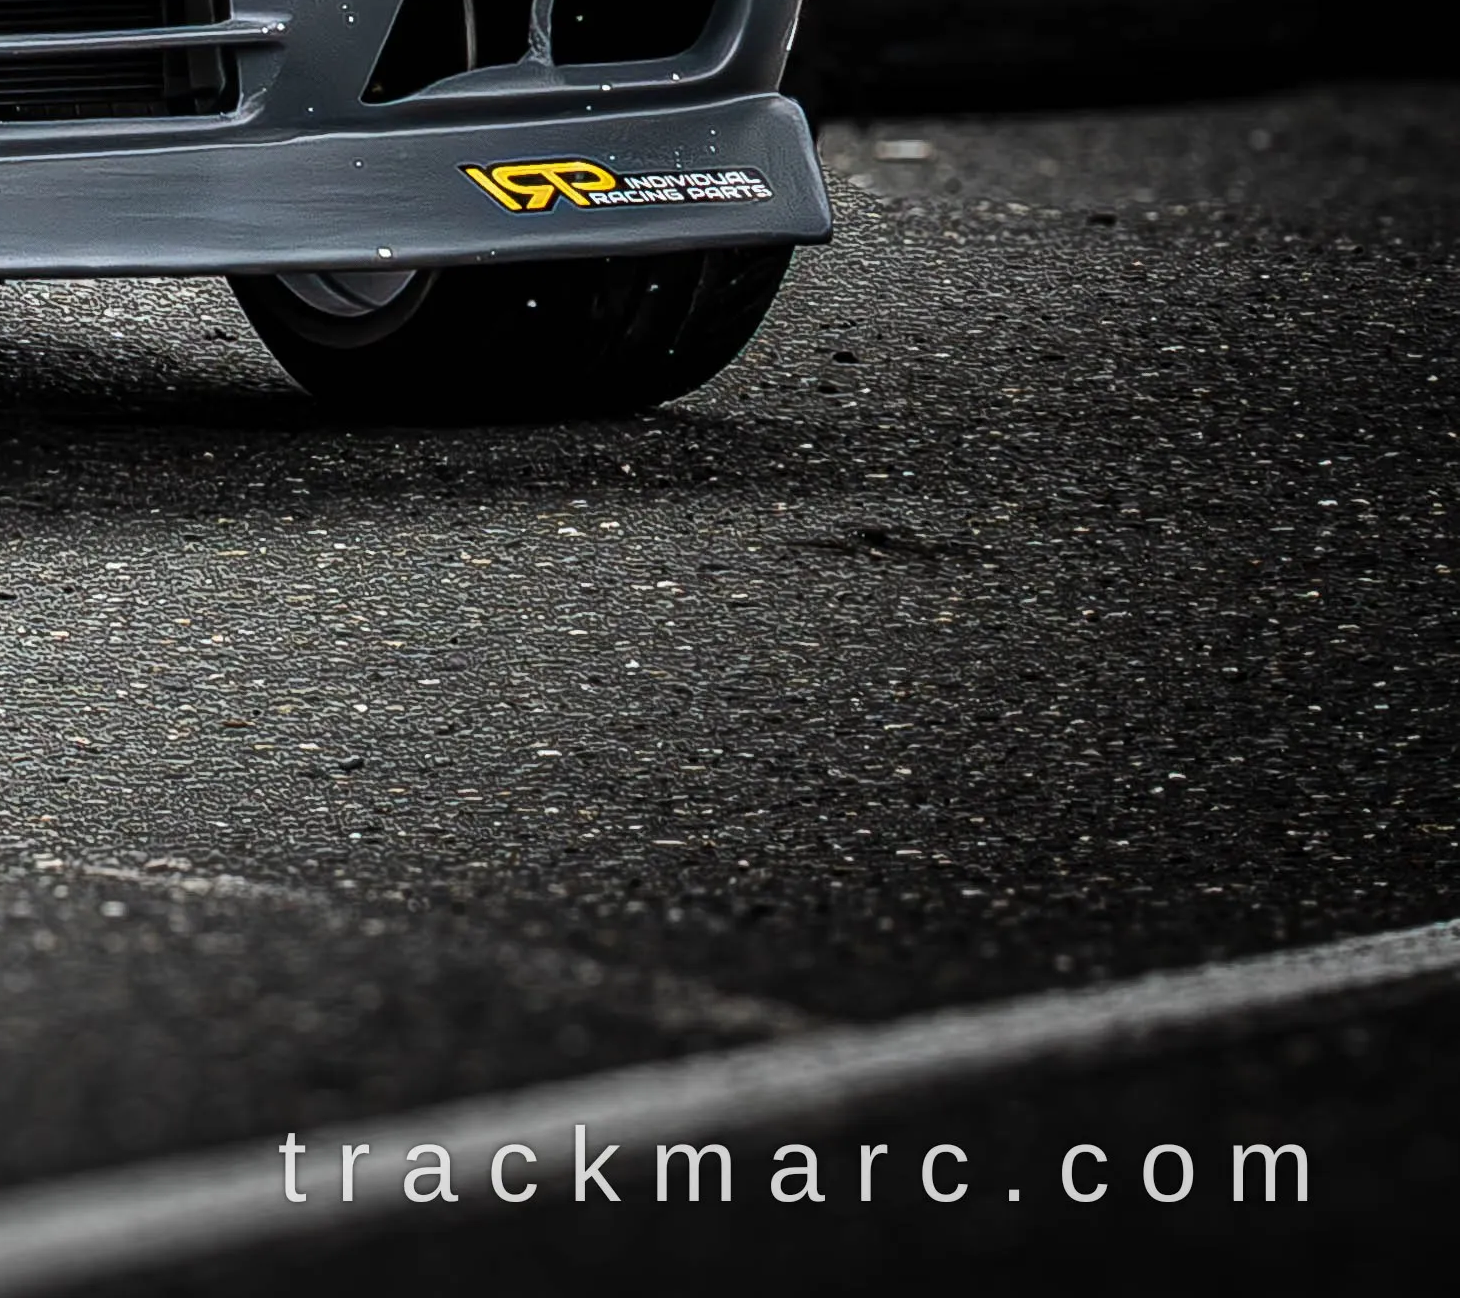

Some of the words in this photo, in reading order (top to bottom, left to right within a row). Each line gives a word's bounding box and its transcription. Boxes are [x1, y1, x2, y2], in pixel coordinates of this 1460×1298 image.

[624, 169, 762, 190] INDIVIDUAL
[588, 188, 681, 205] RACING
[690, 183, 774, 200] PARTS
